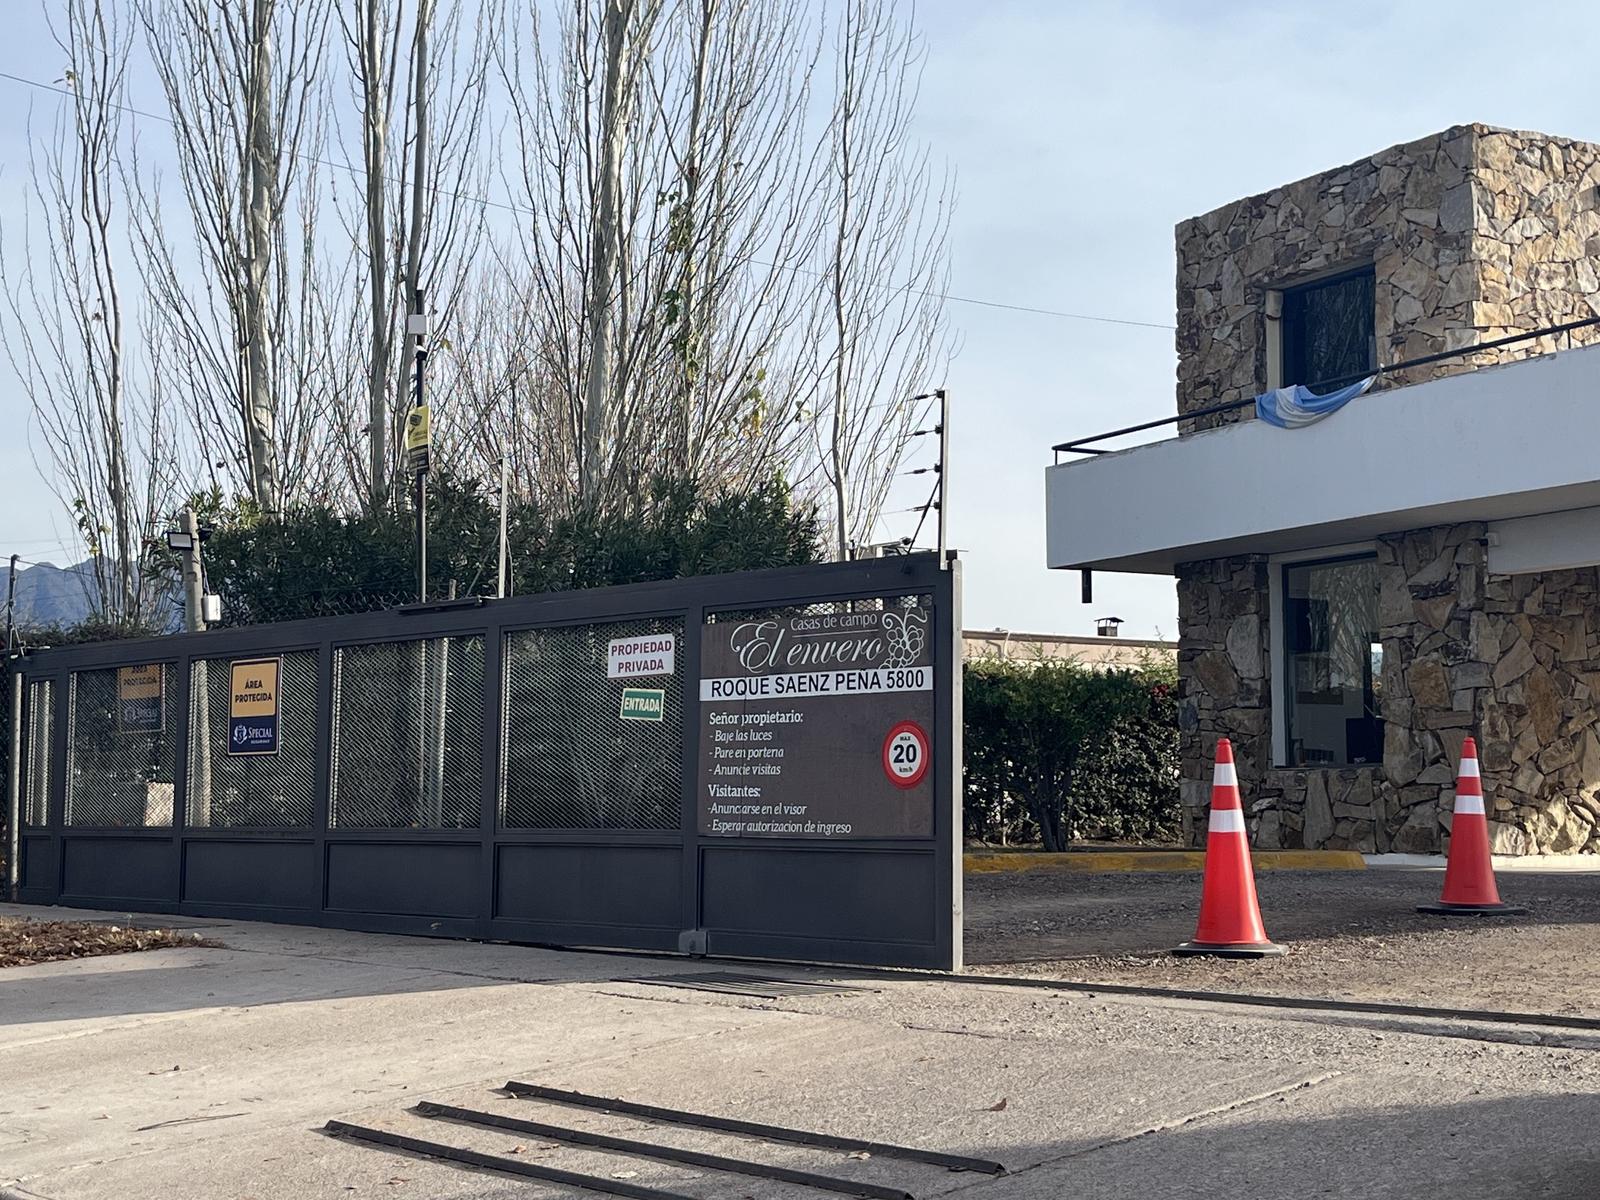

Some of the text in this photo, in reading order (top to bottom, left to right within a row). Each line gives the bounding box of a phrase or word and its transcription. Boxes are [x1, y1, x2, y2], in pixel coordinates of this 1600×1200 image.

[790, 613, 878, 631] Casas de campo
[611, 640, 672, 657] PROPIEDAD
[730, 621, 886, 674] El envero
[617, 658, 665, 674] PRIVADA
[244, 678, 263, 690] ÁREA
[711, 669, 924, 698] ROQUE SAENZ PEÑA 5800
[234, 692, 273, 704] PROTEGIDA
[623, 697, 660, 713] ENTRADA
[709, 709, 804, 727] Señor propietario:
[714, 729, 734, 744] Baje
[735, 729, 749, 741] las
[749, 728, 773, 741] luces
[713, 746, 734, 759] Pare
[734, 748, 746, 758] en
[893, 743, 917, 764] 20
[713, 763, 751, 776] Anuncie
[751, 763, 782, 776] visitas
[707, 784, 761, 798] Visitantes:
[761, 805, 773, 815] en
[773, 802, 783, 815] el
[783, 803, 808, 816] visor
[711, 818, 747, 834] Esperar
[803, 820, 816, 833] de
[816, 820, 852, 836] ingreso
